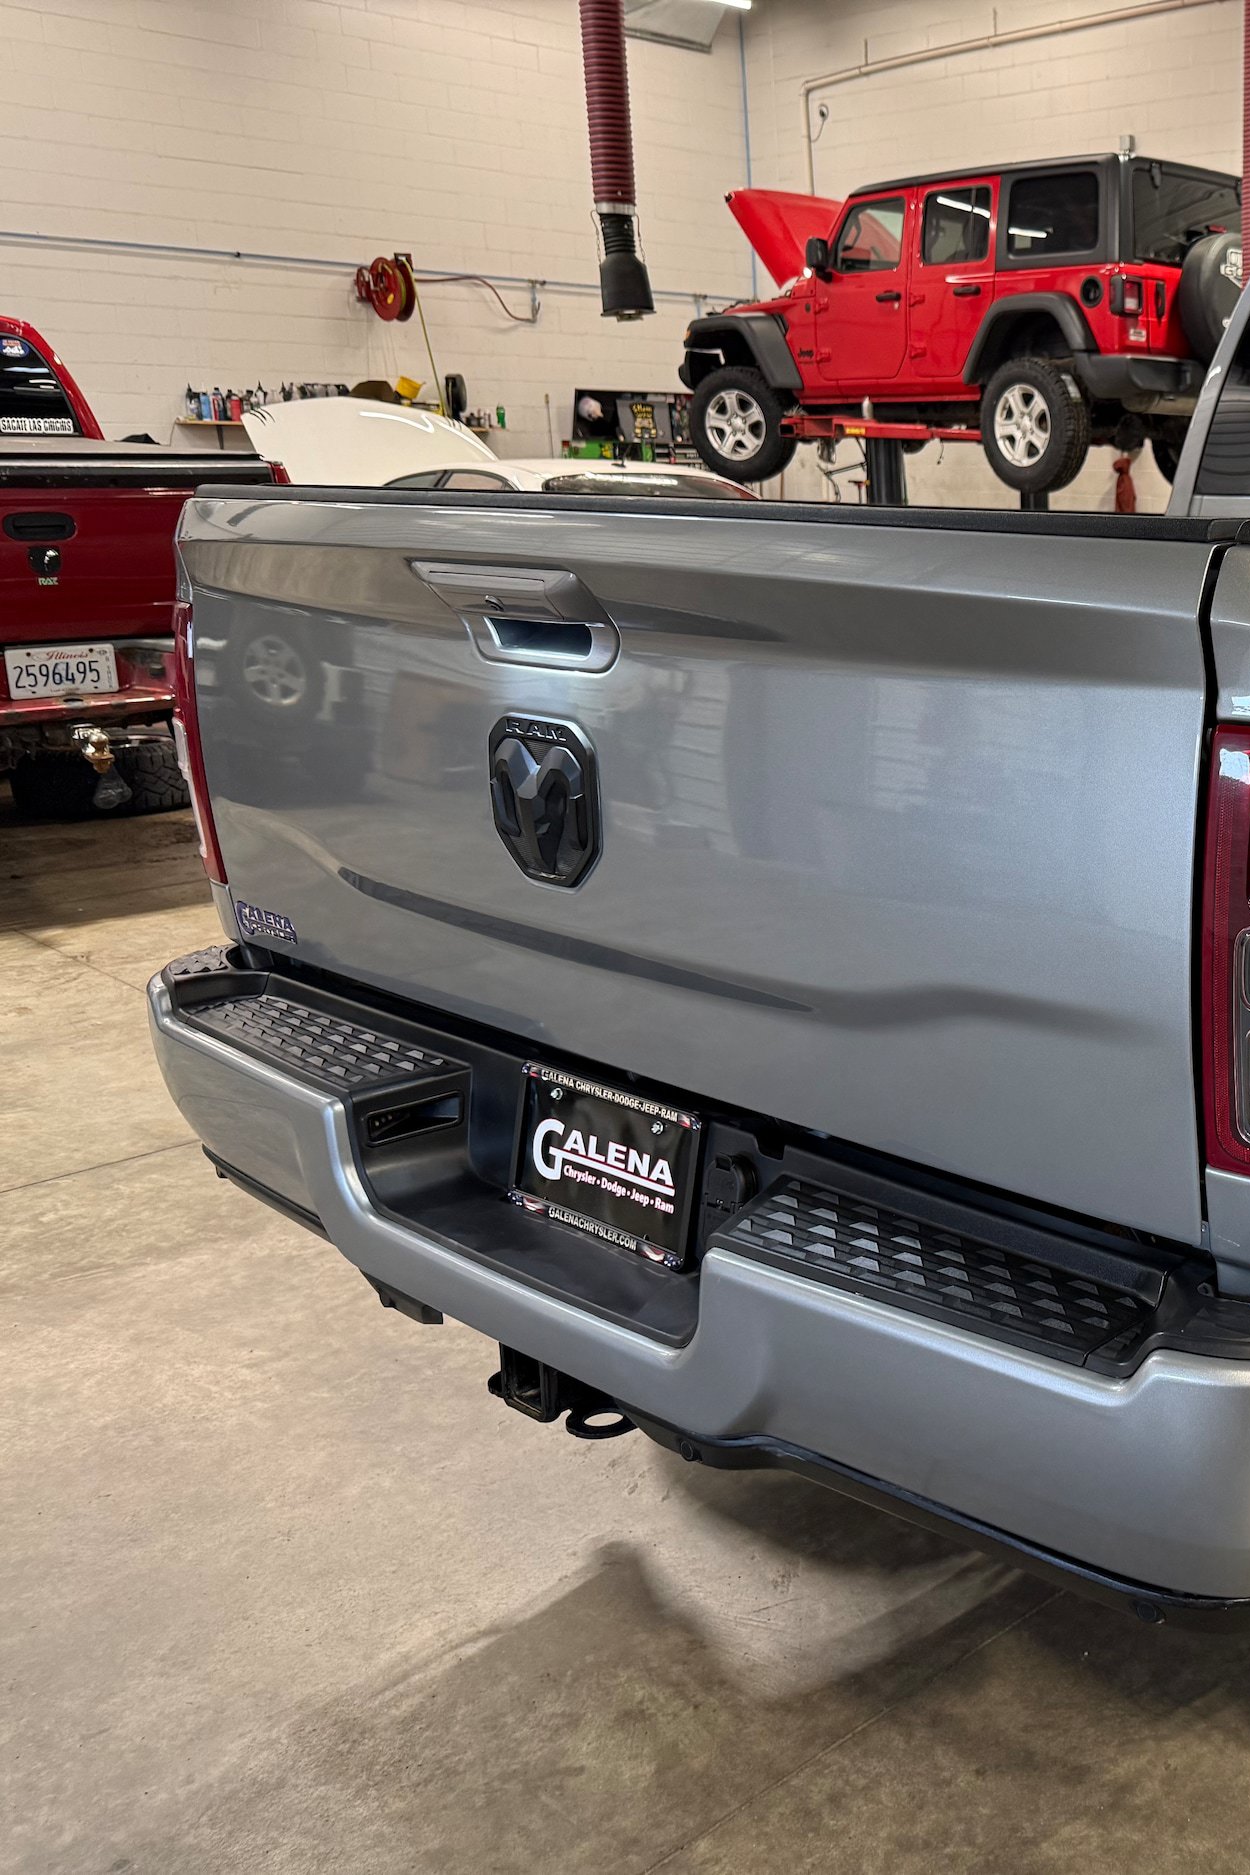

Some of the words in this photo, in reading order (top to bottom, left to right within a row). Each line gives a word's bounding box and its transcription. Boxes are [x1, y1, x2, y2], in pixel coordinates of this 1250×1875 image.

[46, 650, 89, 661] Illinois
[12, 659, 101, 690] 2596495
[505, 719, 567, 742] RAM
[235, 900, 296, 936] GALENA
[541, 1068, 575, 1089] GALENA
[532, 1118, 676, 1192] GALENA
[563, 1164, 597, 1186] Chrysler
[600, 1178, 627, 1198] Dodge
[629, 1187, 650, 1208] Jeep
[654, 1197, 675, 1215] Ram
[548, 1206, 638, 1251] GALENACHRYSLER.COM
